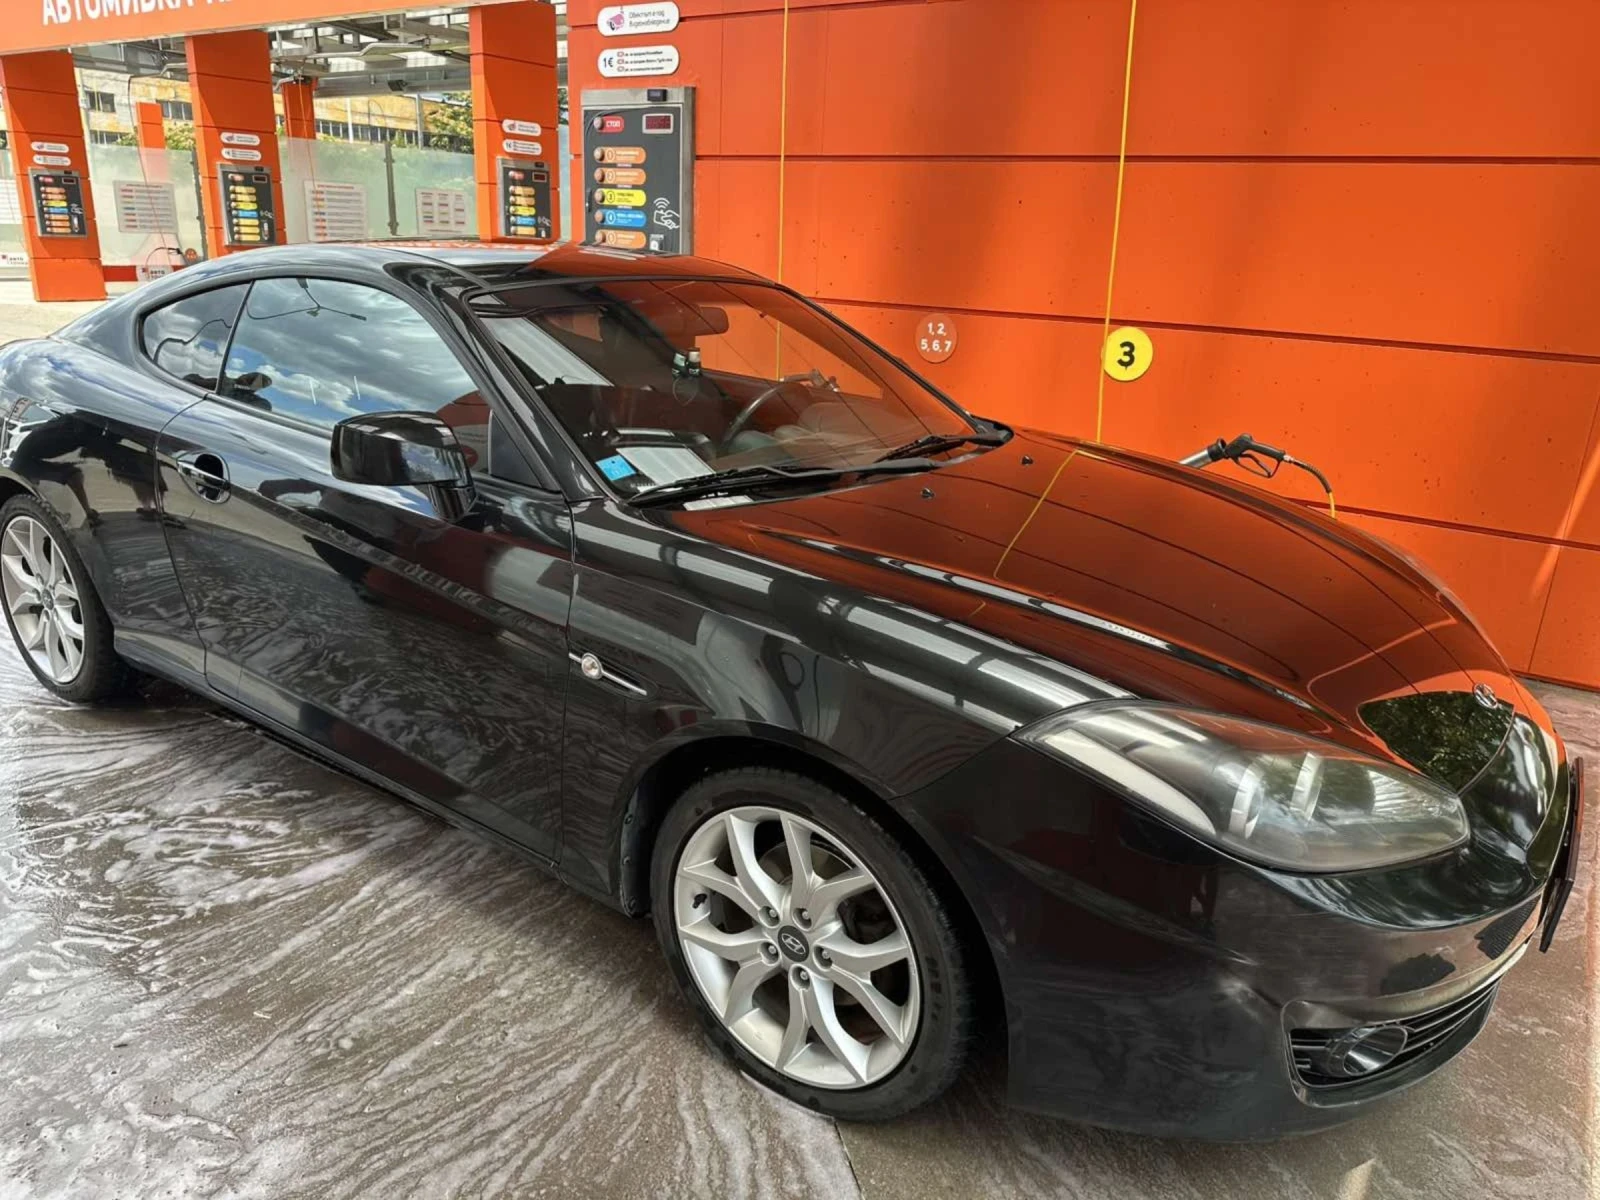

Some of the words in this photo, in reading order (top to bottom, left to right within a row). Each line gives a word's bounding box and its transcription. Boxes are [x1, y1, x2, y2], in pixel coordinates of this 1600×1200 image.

[43, 0, 195, 26] АВТОМ
[603, 57, 614, 68] 1€
[944, 339, 952, 353] 7
[1116, 341, 1136, 368] 3
